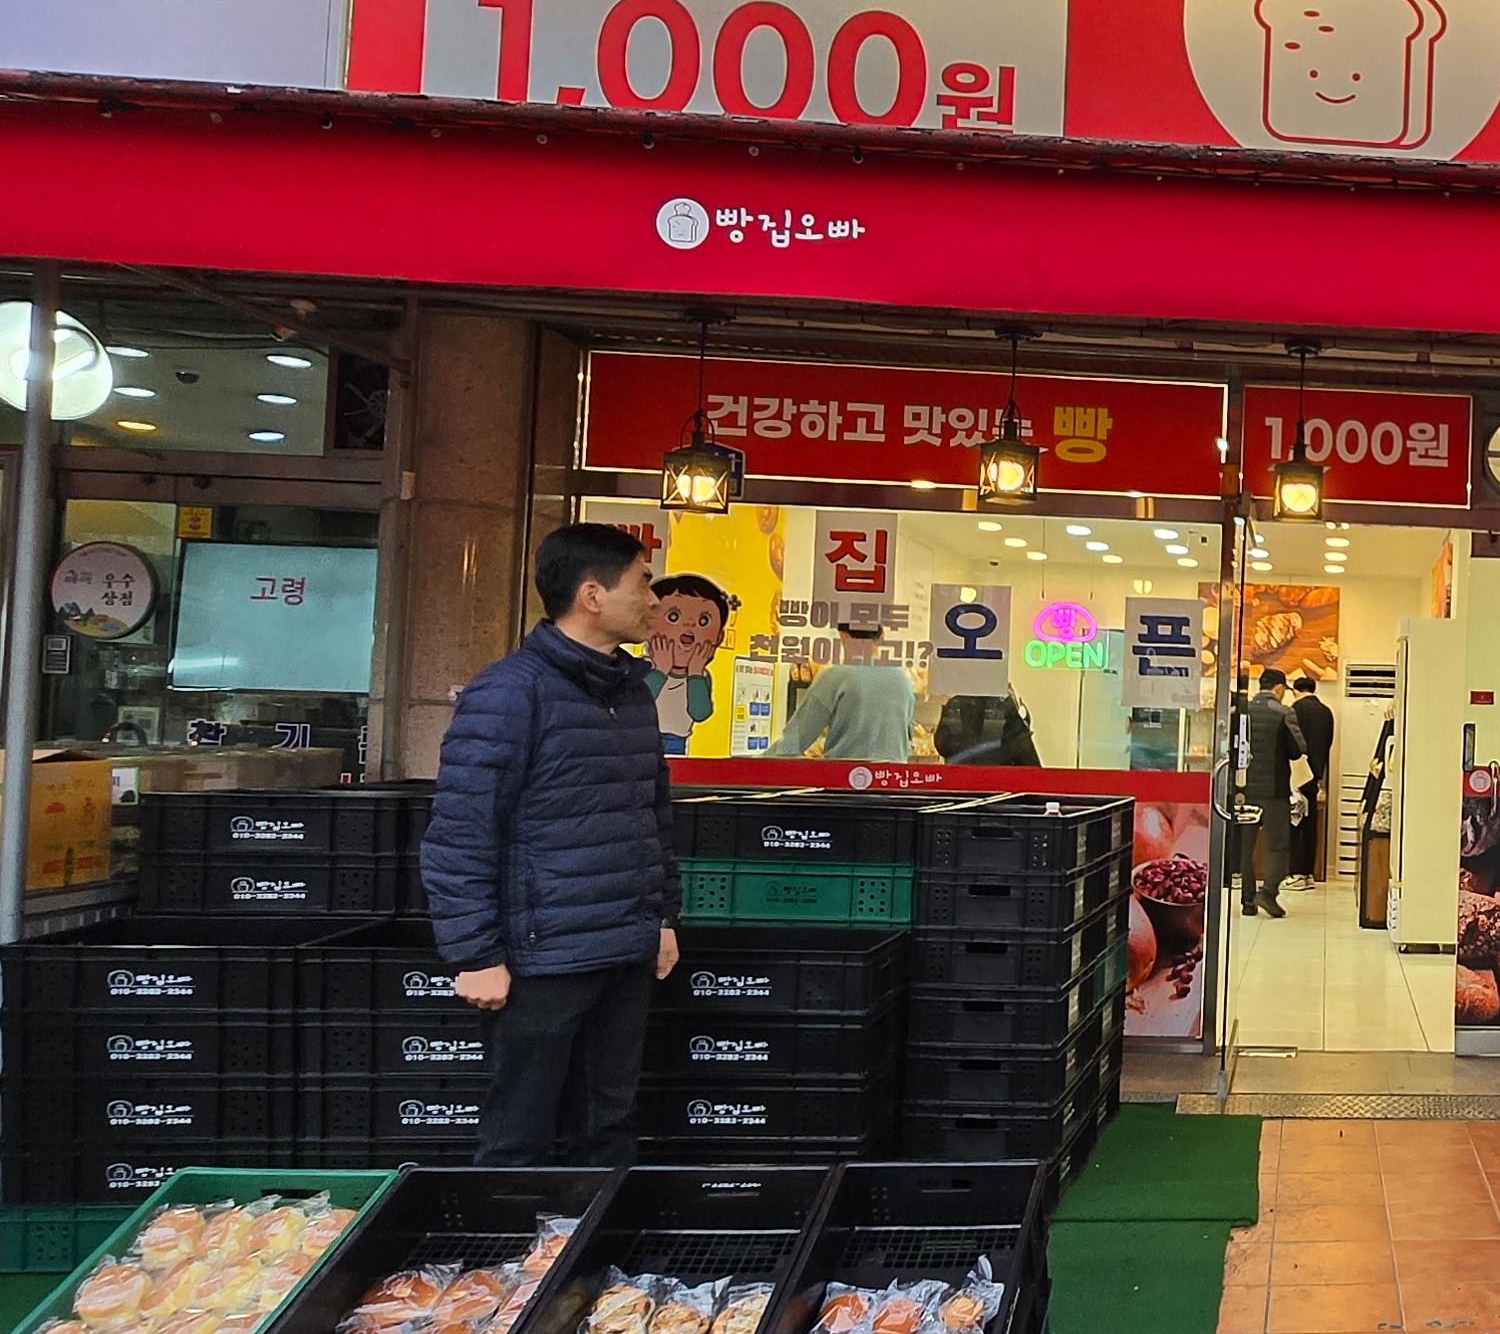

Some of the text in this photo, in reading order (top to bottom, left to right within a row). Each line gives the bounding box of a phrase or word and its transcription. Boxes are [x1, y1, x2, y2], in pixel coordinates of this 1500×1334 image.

[715, 207, 865, 247] 빵집오빠
[708, 395, 885, 442] 건강하고
[1054, 406, 1112, 462] 빵
[1265, 415, 1449, 468] 1000원
[826, 529, 888, 592] 집
[250, 576, 305, 606] 고령
[851, 603, 909, 631] 모두
[937, 604, 1003, 659] 오
[1051, 609, 1080, 639] 빵
[1025, 640, 1103, 668] OPEN
[1132, 615, 1196, 676] 픈
[875, 768, 943, 787] 빵집오빠
[135, 1167, 175, 1177] 빵집오
